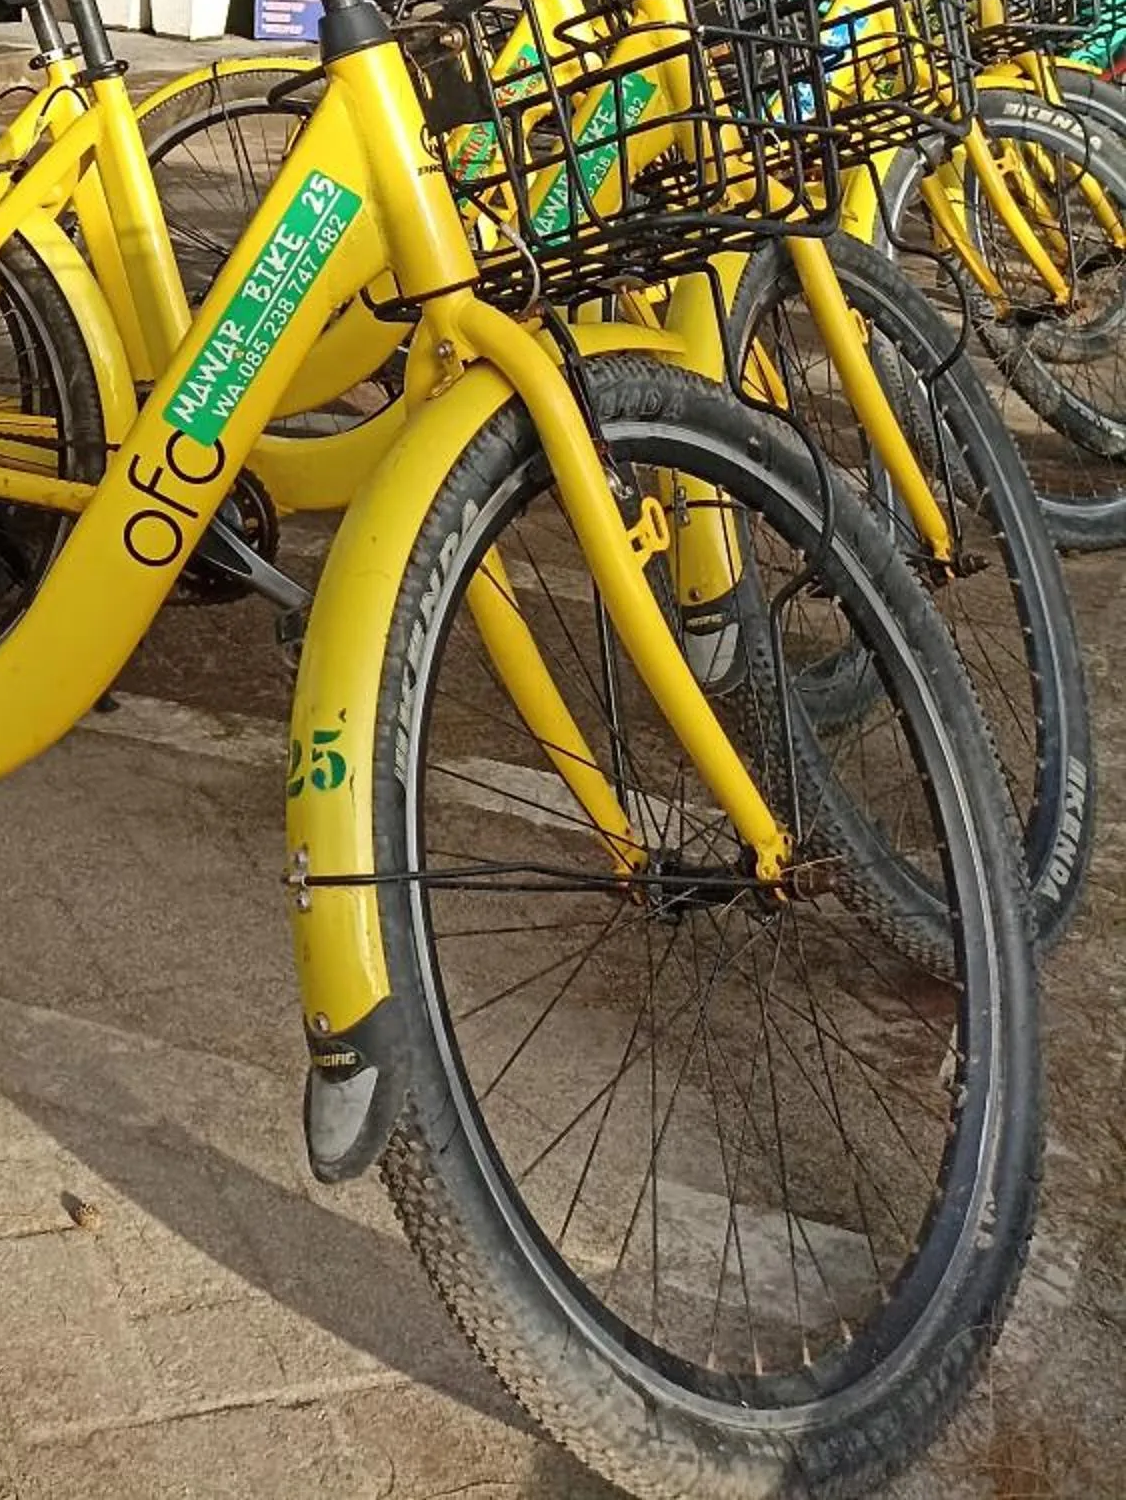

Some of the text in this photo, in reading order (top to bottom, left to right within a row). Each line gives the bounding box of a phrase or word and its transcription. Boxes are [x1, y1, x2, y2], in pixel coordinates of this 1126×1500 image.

[173, 173, 336, 424] MAWAR BIKE 25
[211, 213, 348, 419] WA:085 238 747 482
